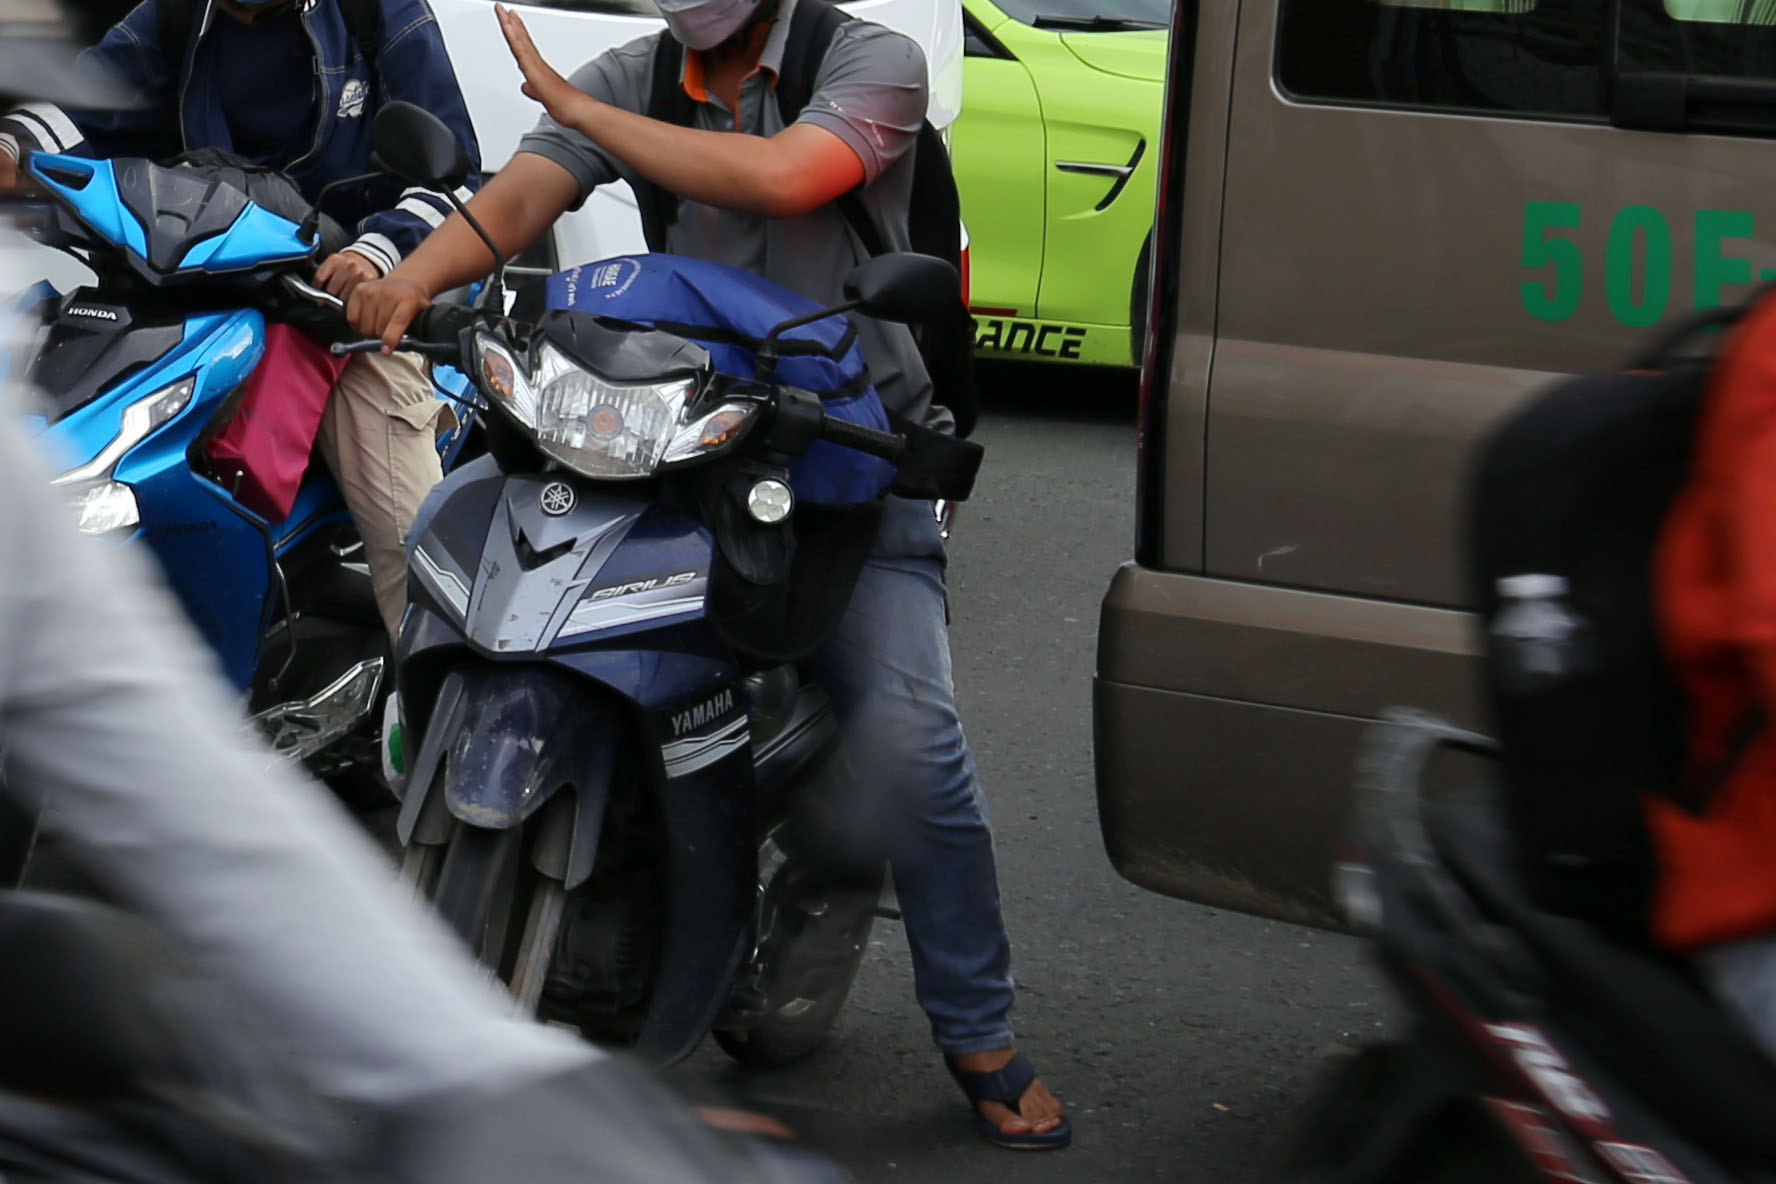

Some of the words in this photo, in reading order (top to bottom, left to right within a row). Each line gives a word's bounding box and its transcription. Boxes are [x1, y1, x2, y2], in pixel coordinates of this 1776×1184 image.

[68, 307, 117, 320] HONDA
[588, 572, 696, 602] SIRIUS
[671, 689, 733, 735] YAMAHA
